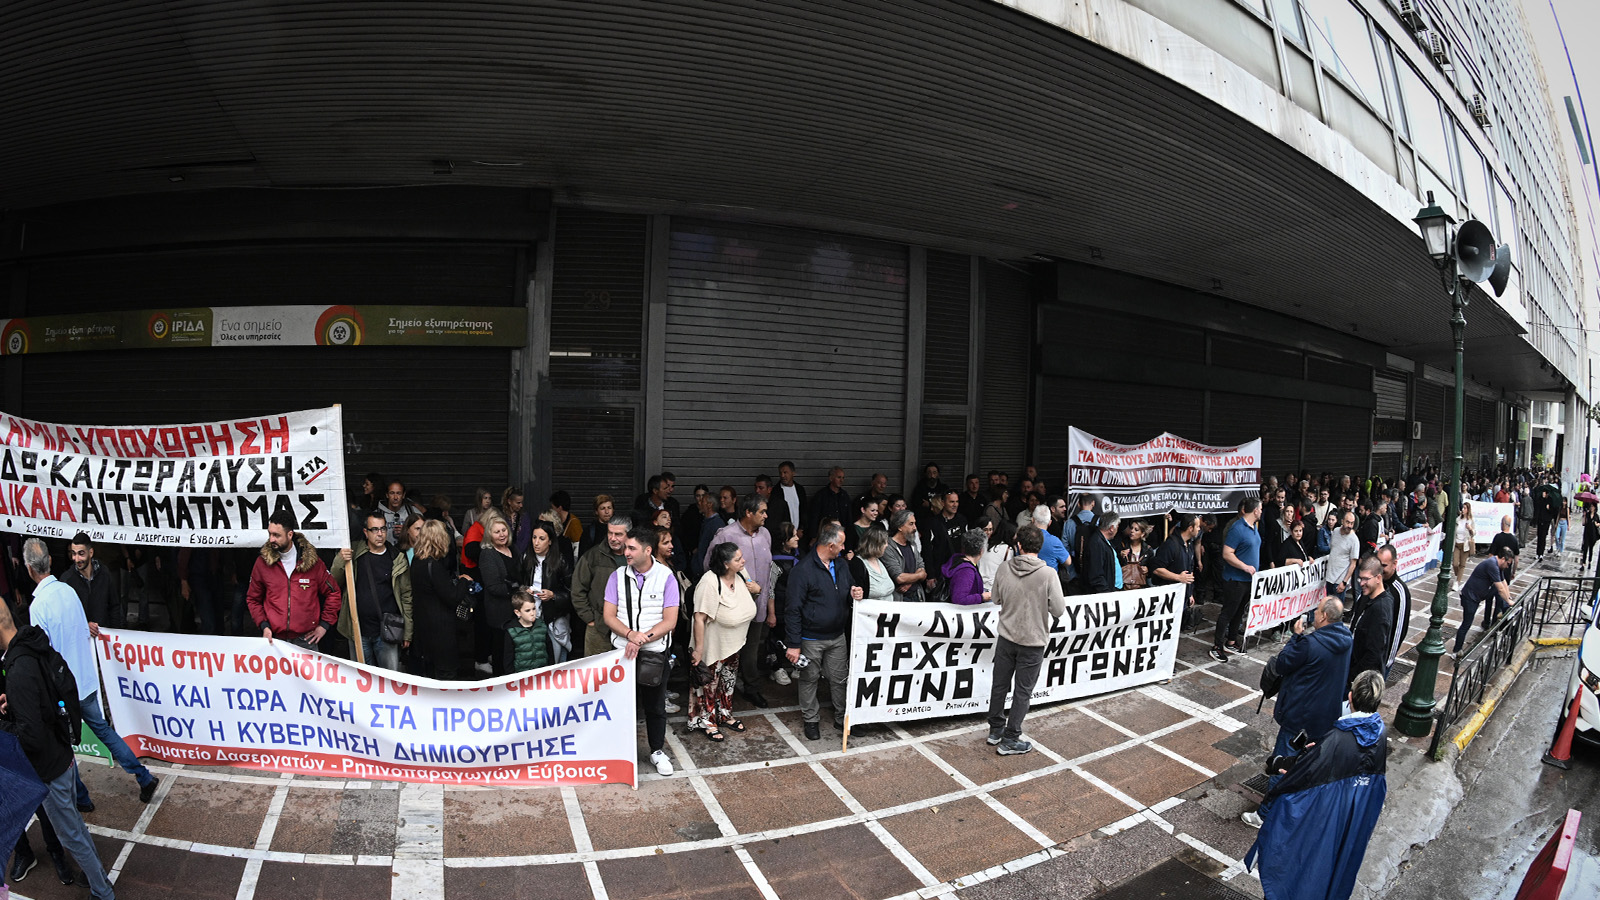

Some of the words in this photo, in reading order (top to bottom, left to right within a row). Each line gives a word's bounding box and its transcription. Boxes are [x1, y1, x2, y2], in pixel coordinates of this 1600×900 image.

[243, 319, 282, 333] σημείο
[246, 333, 281, 341] υπηρεσίες
[388, 318, 422, 329] Σημείο
[424, 318, 493, 330] εξυπηρέτησης
[0, 414, 80, 454] ΑΜΙΑ
[75, 416, 289, 458] ΥΠΟΧΩΡΗΣΗ
[1, 449, 38, 483] ΔΩ
[50, 455, 108, 490] ΚΑΙ
[115, 460, 196, 493] ΤΩΡΑ
[203, 456, 294, 493] ΛΥΣΗ
[297, 456, 327, 481] ΣΤΑ
[1078, 450, 1094, 462] ΓΙΑ
[1120, 454, 1145, 466] ΤΟΥΣ
[1206, 456, 1222, 466] ΤΗΣ
[1224, 456, 1254, 466] ΛΑΡΚΟ
[82, 492, 232, 530] ΑΙΤΗΜΑΤΑ
[237, 494, 328, 530] ΜΑΣ
[1112, 494, 1150, 505] ΣΥΝΔΙΚΑΤΟ
[1192, 493, 1222, 501] ΑΤΤΙΚΗΣ
[1197, 501, 1229, 509] ΕΛΛΑΔΑΣ
[113, 532, 127, 541] ΚΑΙ
[134, 533, 181, 543] ΔΑΣΕΡΓΑΤΩΝ
[1254, 570, 1299, 600] ΕΝΑΝΤΙΑ
[1300, 563, 1321, 587] ΣΤΗΝ
[876, 613, 900, 637] Η
[1133, 592, 1175, 620] ΔΕΝ
[1248, 596, 1297, 629] ΣΩΜΑΤΕΙΟ
[864, 641, 994, 672] ΕΡΧΕΤ
[1043, 625, 1129, 658] ΜΟΝΗ
[1134, 618, 1174, 645] ΤΗΣ
[98, 634, 164, 672] Τέρμα
[172, 649, 225, 677] στην
[234, 653, 347, 684] κοροϊδία.
[506, 659, 626, 697] εμπαιγμό
[855, 668, 973, 708] ΜΟΝΟ
[1046, 645, 1159, 687] ΑΓΩΝΕΣ
[117, 677, 162, 704] ΕΔΩ
[172, 684, 211, 708] ΚΑΙ
[222, 688, 287, 712] ΤΩΡΑ
[299, 693, 355, 724] ΛΥΣΗ
[370, 703, 417, 730] ΣΤΑ
[432, 699, 612, 733] ΠΡΟΒΛΗΜΑΤΑ
[151, 714, 195, 739] ΠΟΥ
[209, 720, 225, 741] Η
[237, 721, 380, 757] ΚΥΒΕΡΝΗΣΗ
[394, 734, 577, 763] ΔΗΜΙΟΥΡΓΗΣΕ
[138, 737, 211, 761] Σωματείο
[216, 749, 325, 771] Δασεργατών
[342, 758, 521, 784] Ρητινοπαραγωγών
[527, 764, 608, 781] Εύβοιας
